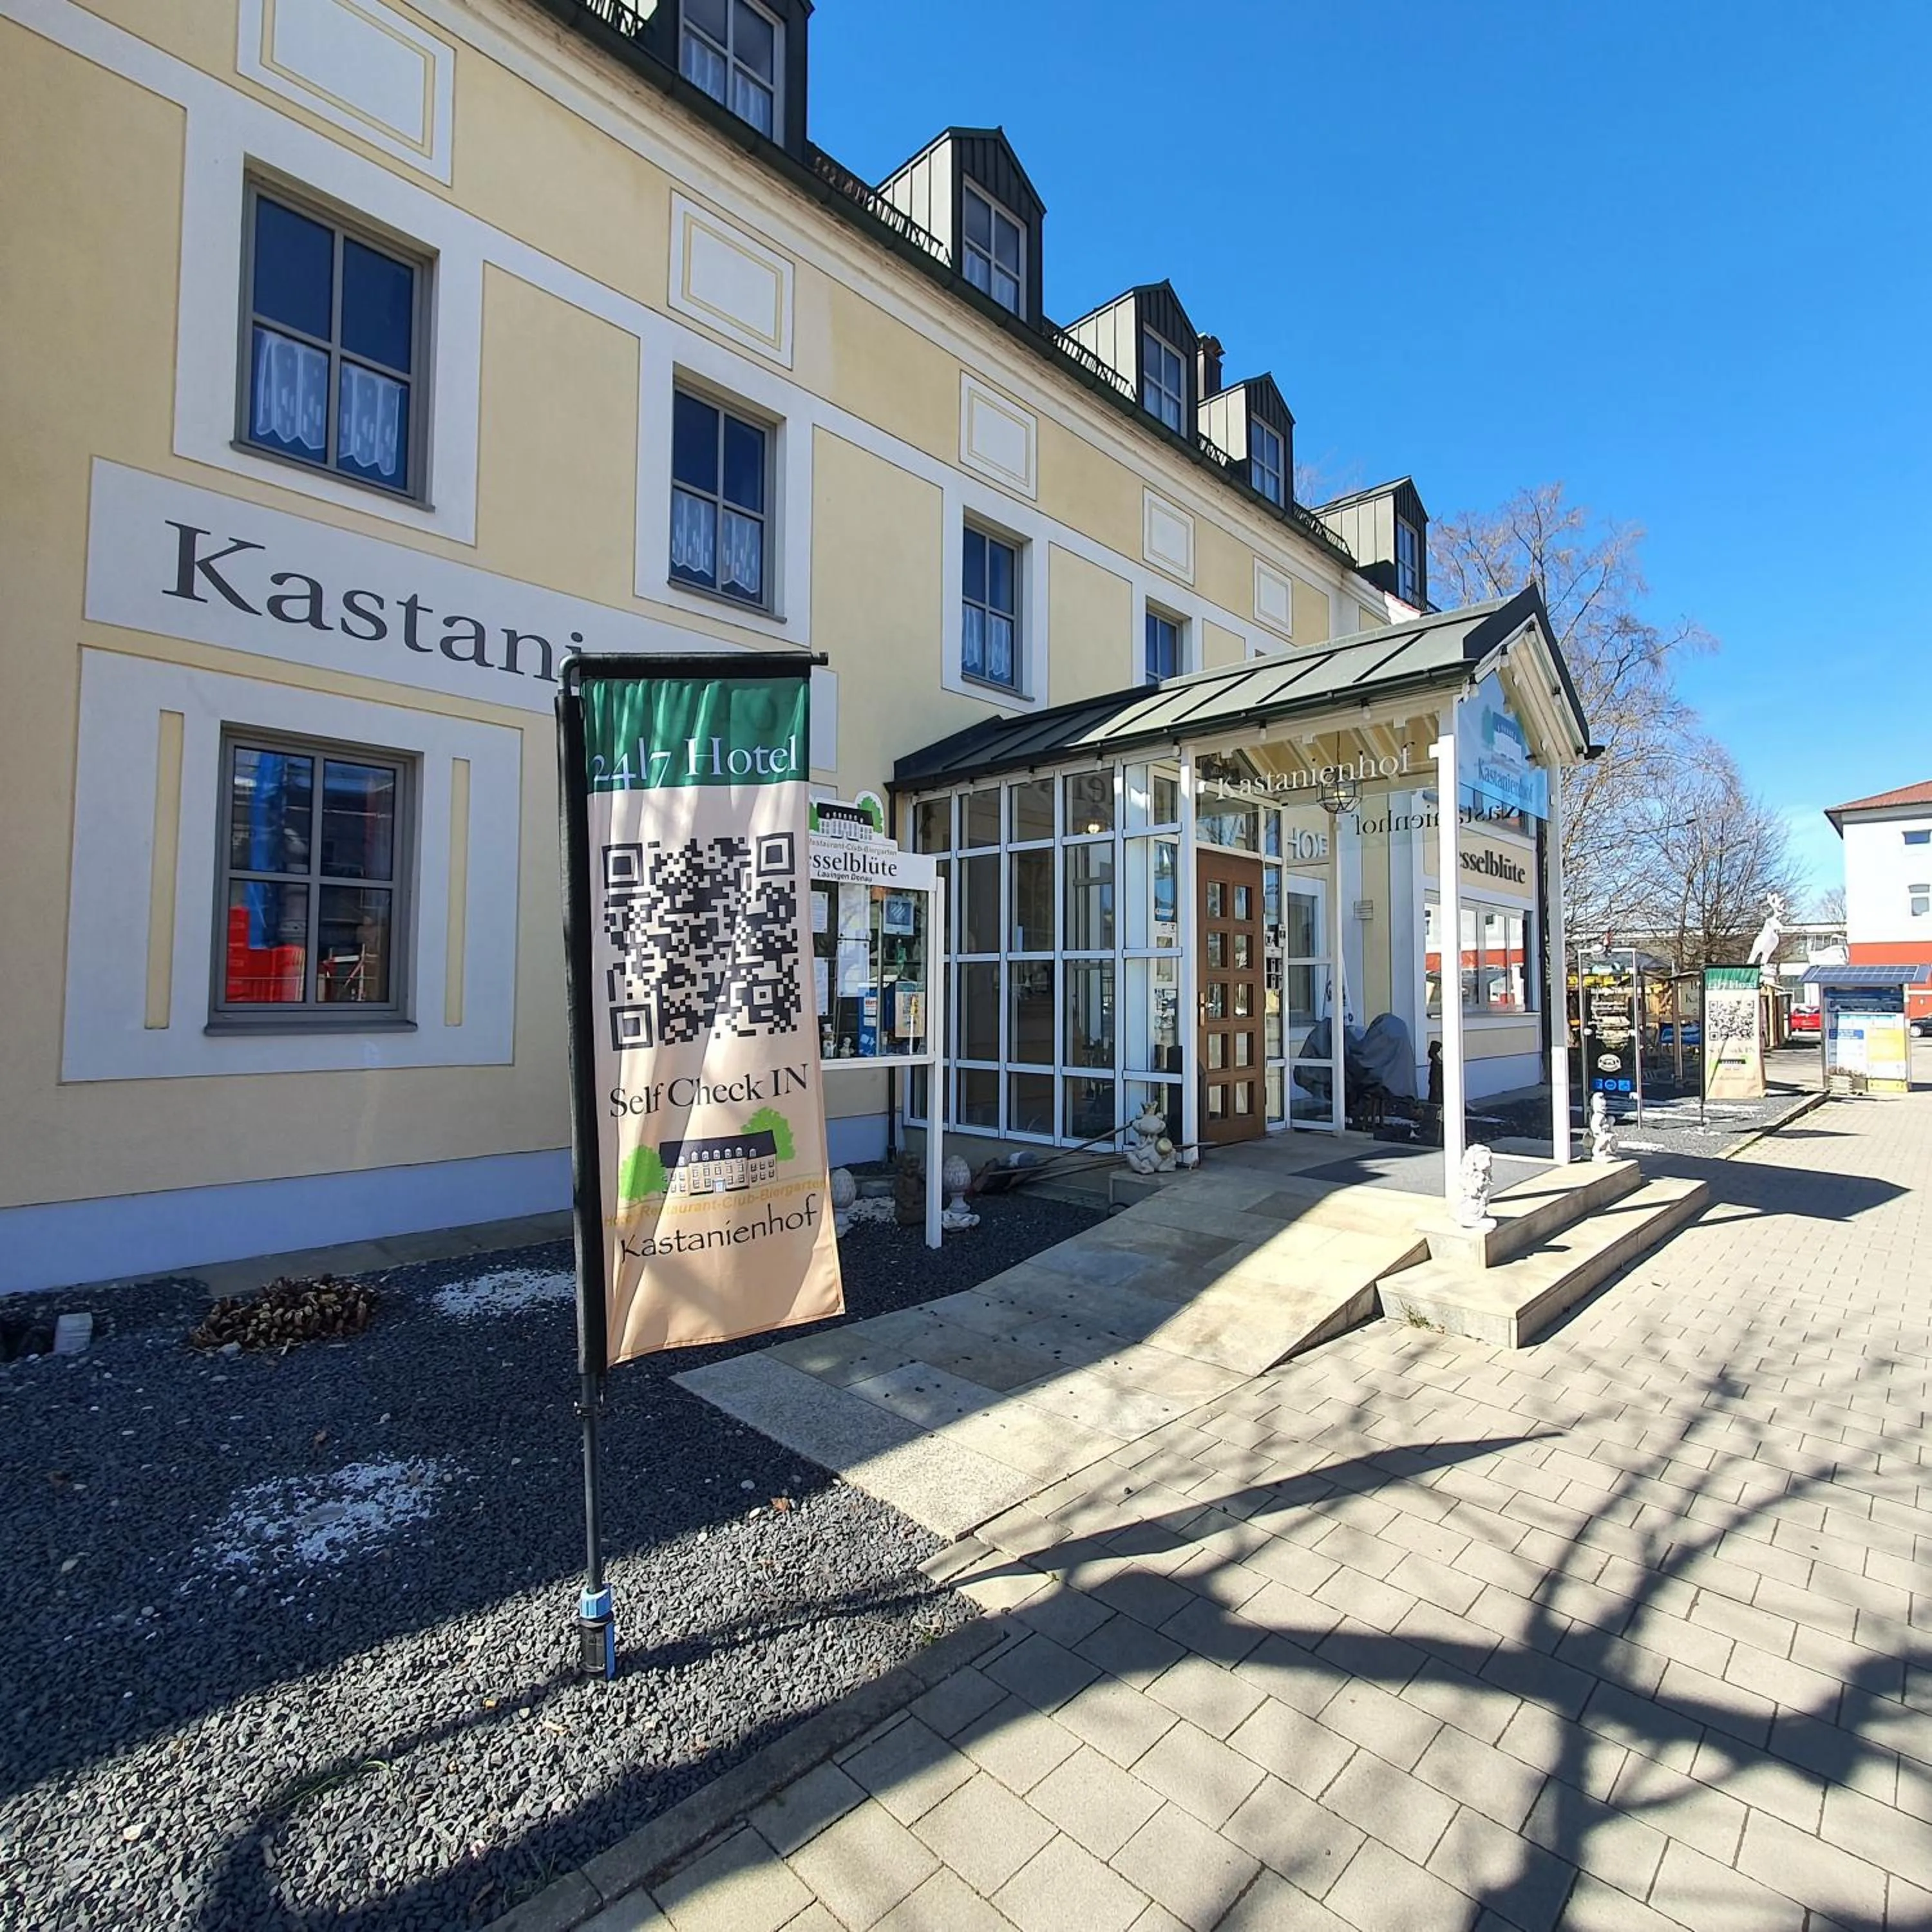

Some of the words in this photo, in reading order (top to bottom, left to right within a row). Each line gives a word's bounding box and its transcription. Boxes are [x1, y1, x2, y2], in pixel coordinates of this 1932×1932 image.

[685, 735, 799, 775] Hotel
[1216, 742, 1415, 800] Kastanienhof
[1479, 757, 1533, 803] Kastanienhof
[810, 851, 897, 876] sselblüte
[1459, 849, 1526, 884] sselblüte
[771, 1063, 809, 1097] IN
[621, 1194, 818, 1264] Kastanienhof
